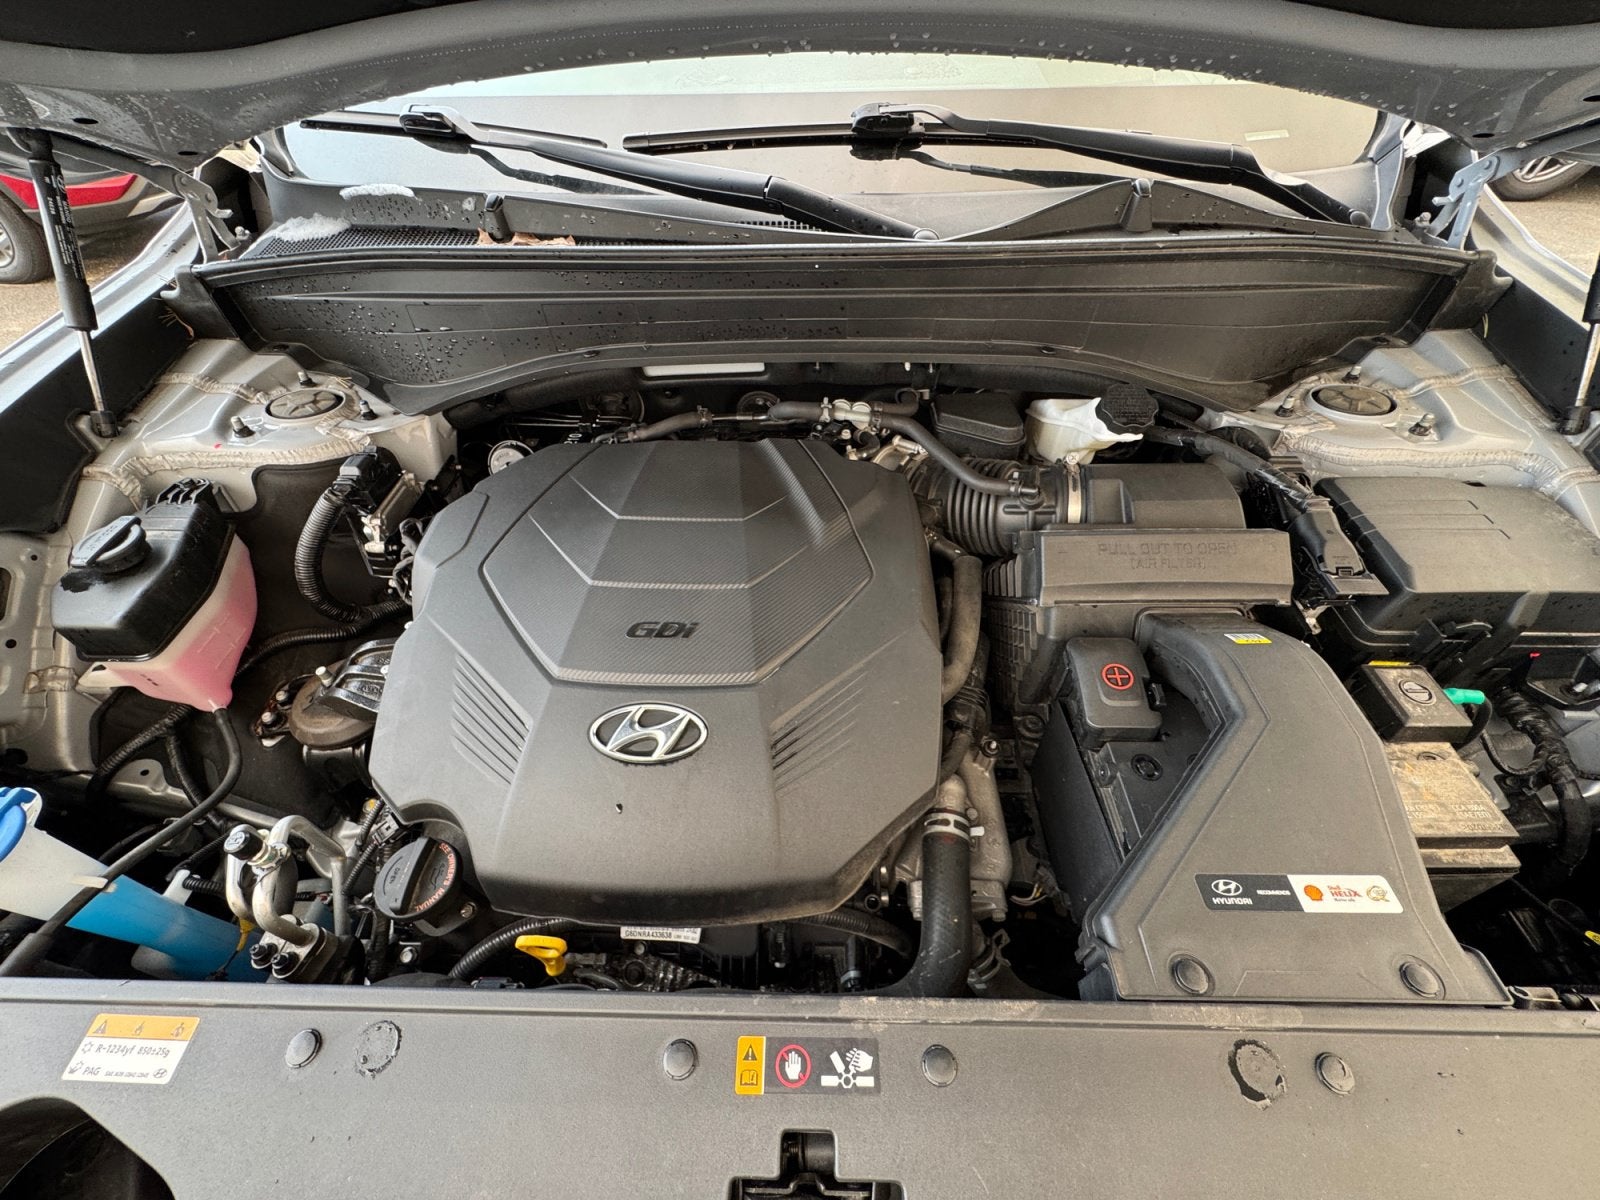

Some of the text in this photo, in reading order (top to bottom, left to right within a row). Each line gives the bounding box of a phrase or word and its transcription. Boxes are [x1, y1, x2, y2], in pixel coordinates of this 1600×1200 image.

[1098, 543, 1237, 555] PULL OUT TO OPEN
[439, 842, 451, 855] SEE
[389, 867, 401, 885] OPEN
[1330, 888, 1363, 898] HELIX
[415, 888, 445, 912] MANUAL
[1211, 897, 1253, 905] HYUNDAI
[95, 1044, 136, 1057] R-1234yf
[82, 1066, 102, 1076] PAG
